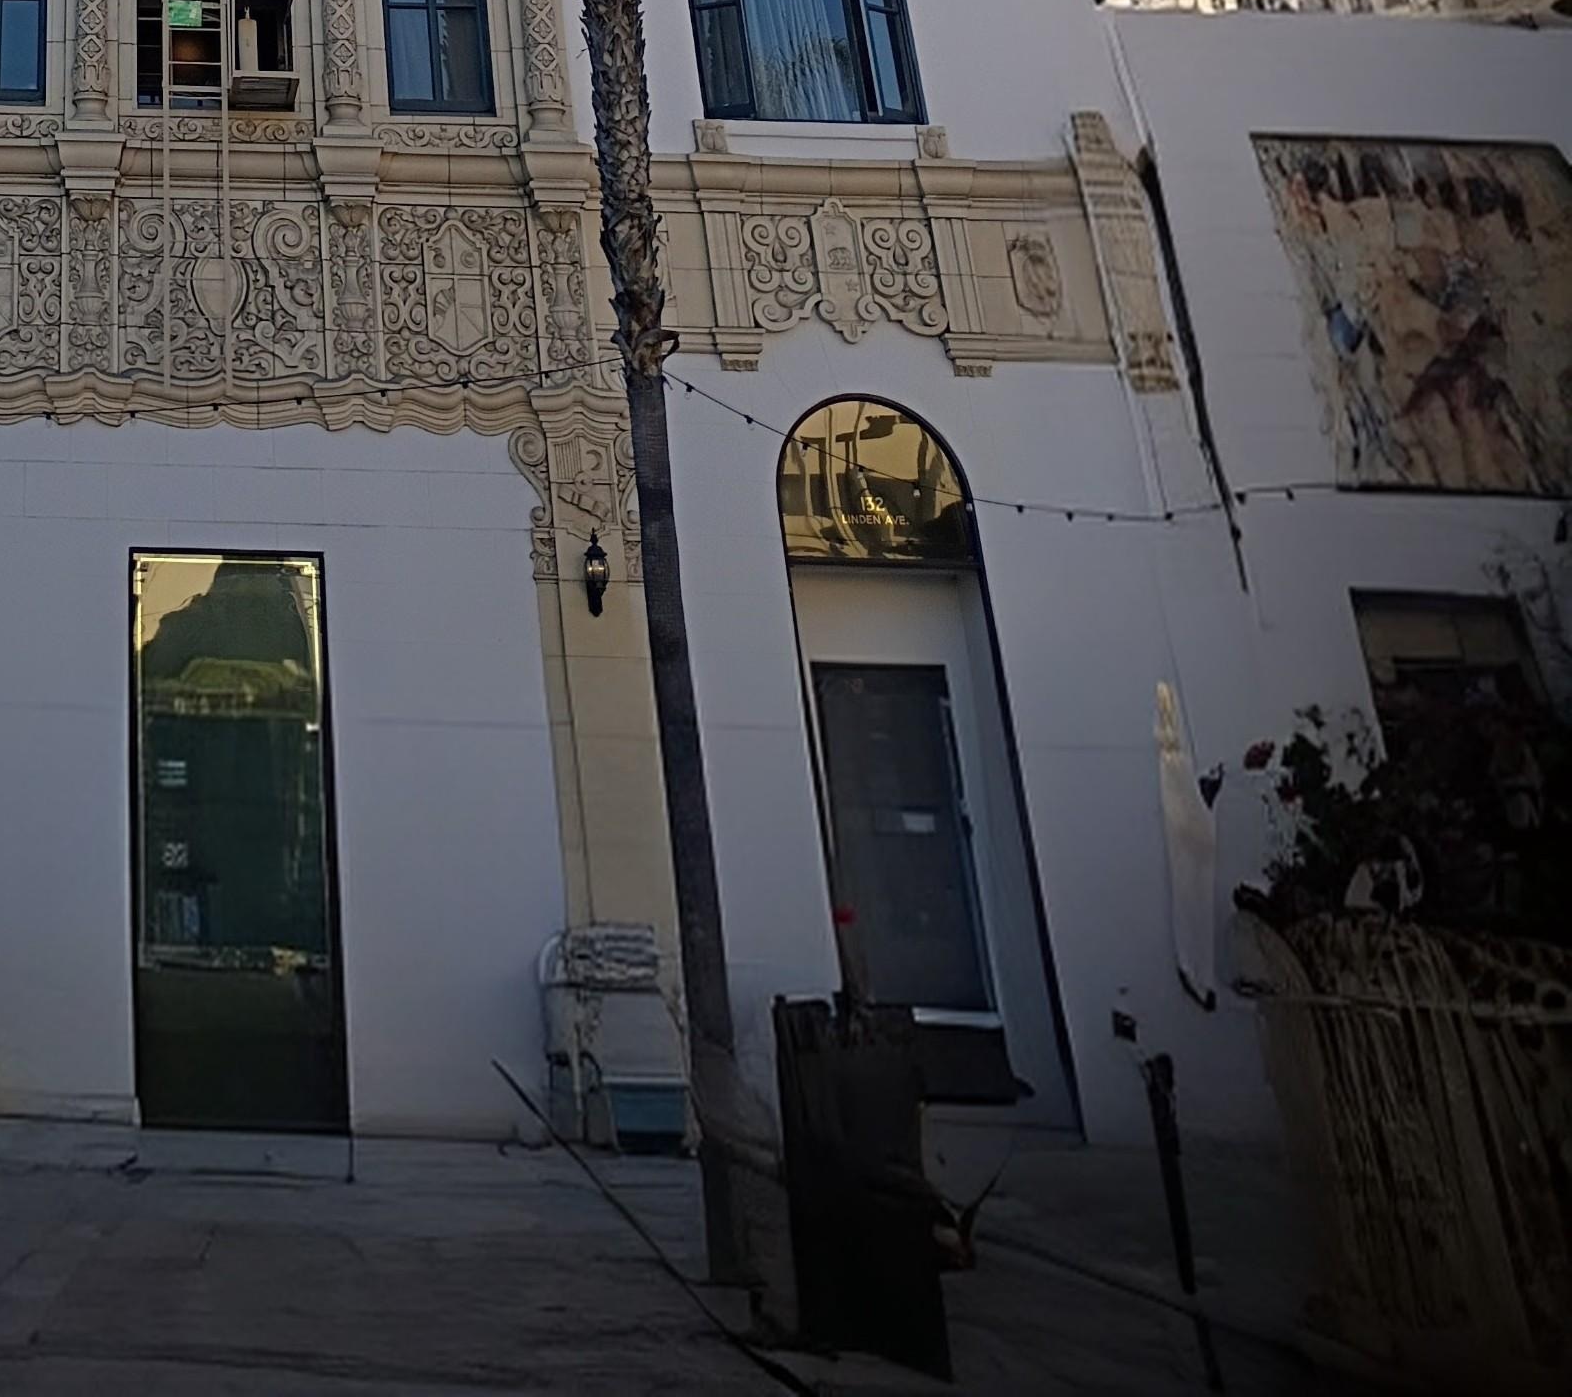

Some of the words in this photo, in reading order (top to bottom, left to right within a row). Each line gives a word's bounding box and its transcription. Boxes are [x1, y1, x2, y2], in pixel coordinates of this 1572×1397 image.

[860, 496, 885, 512] 132
[841, 514, 881, 525] LINDEN
[885, 515, 910, 525] AVE.
